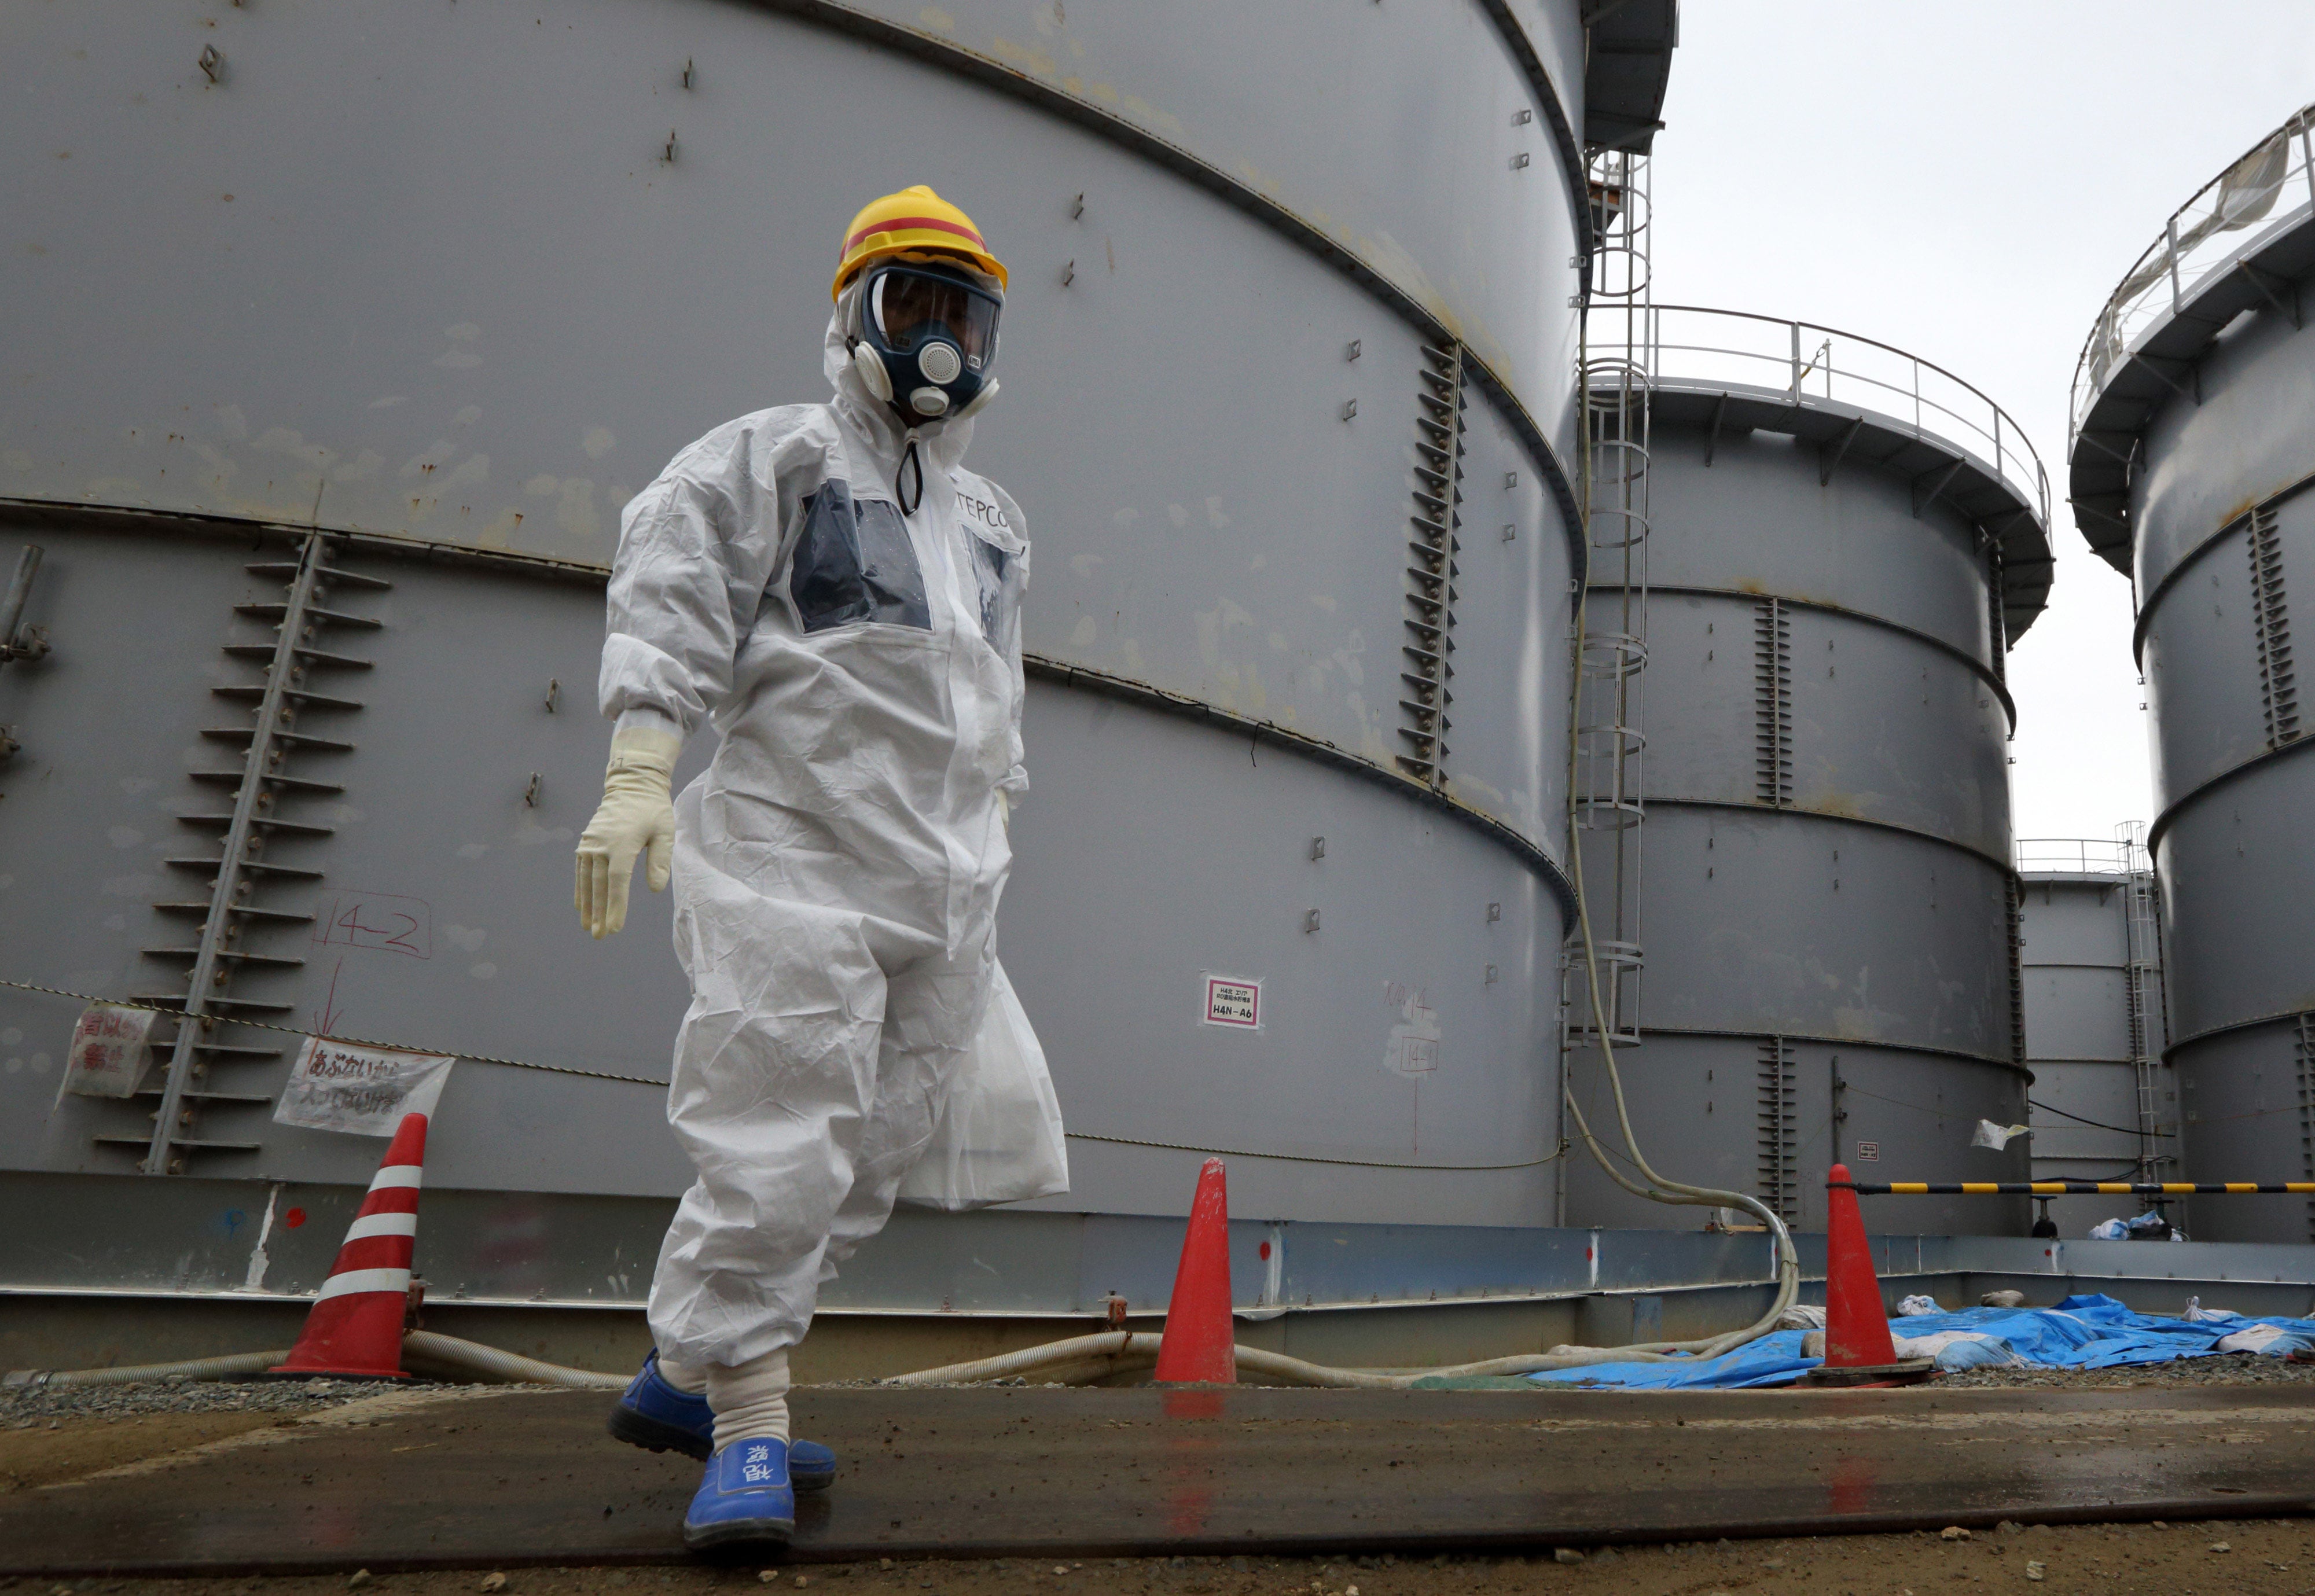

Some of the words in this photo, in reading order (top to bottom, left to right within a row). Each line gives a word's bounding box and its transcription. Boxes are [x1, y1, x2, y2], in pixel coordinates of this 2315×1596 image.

[957, 491, 1008, 527] TEPCO
[324, 898, 419, 953] 14-2
[300, 1083, 406, 1115] 入ってはいけま
